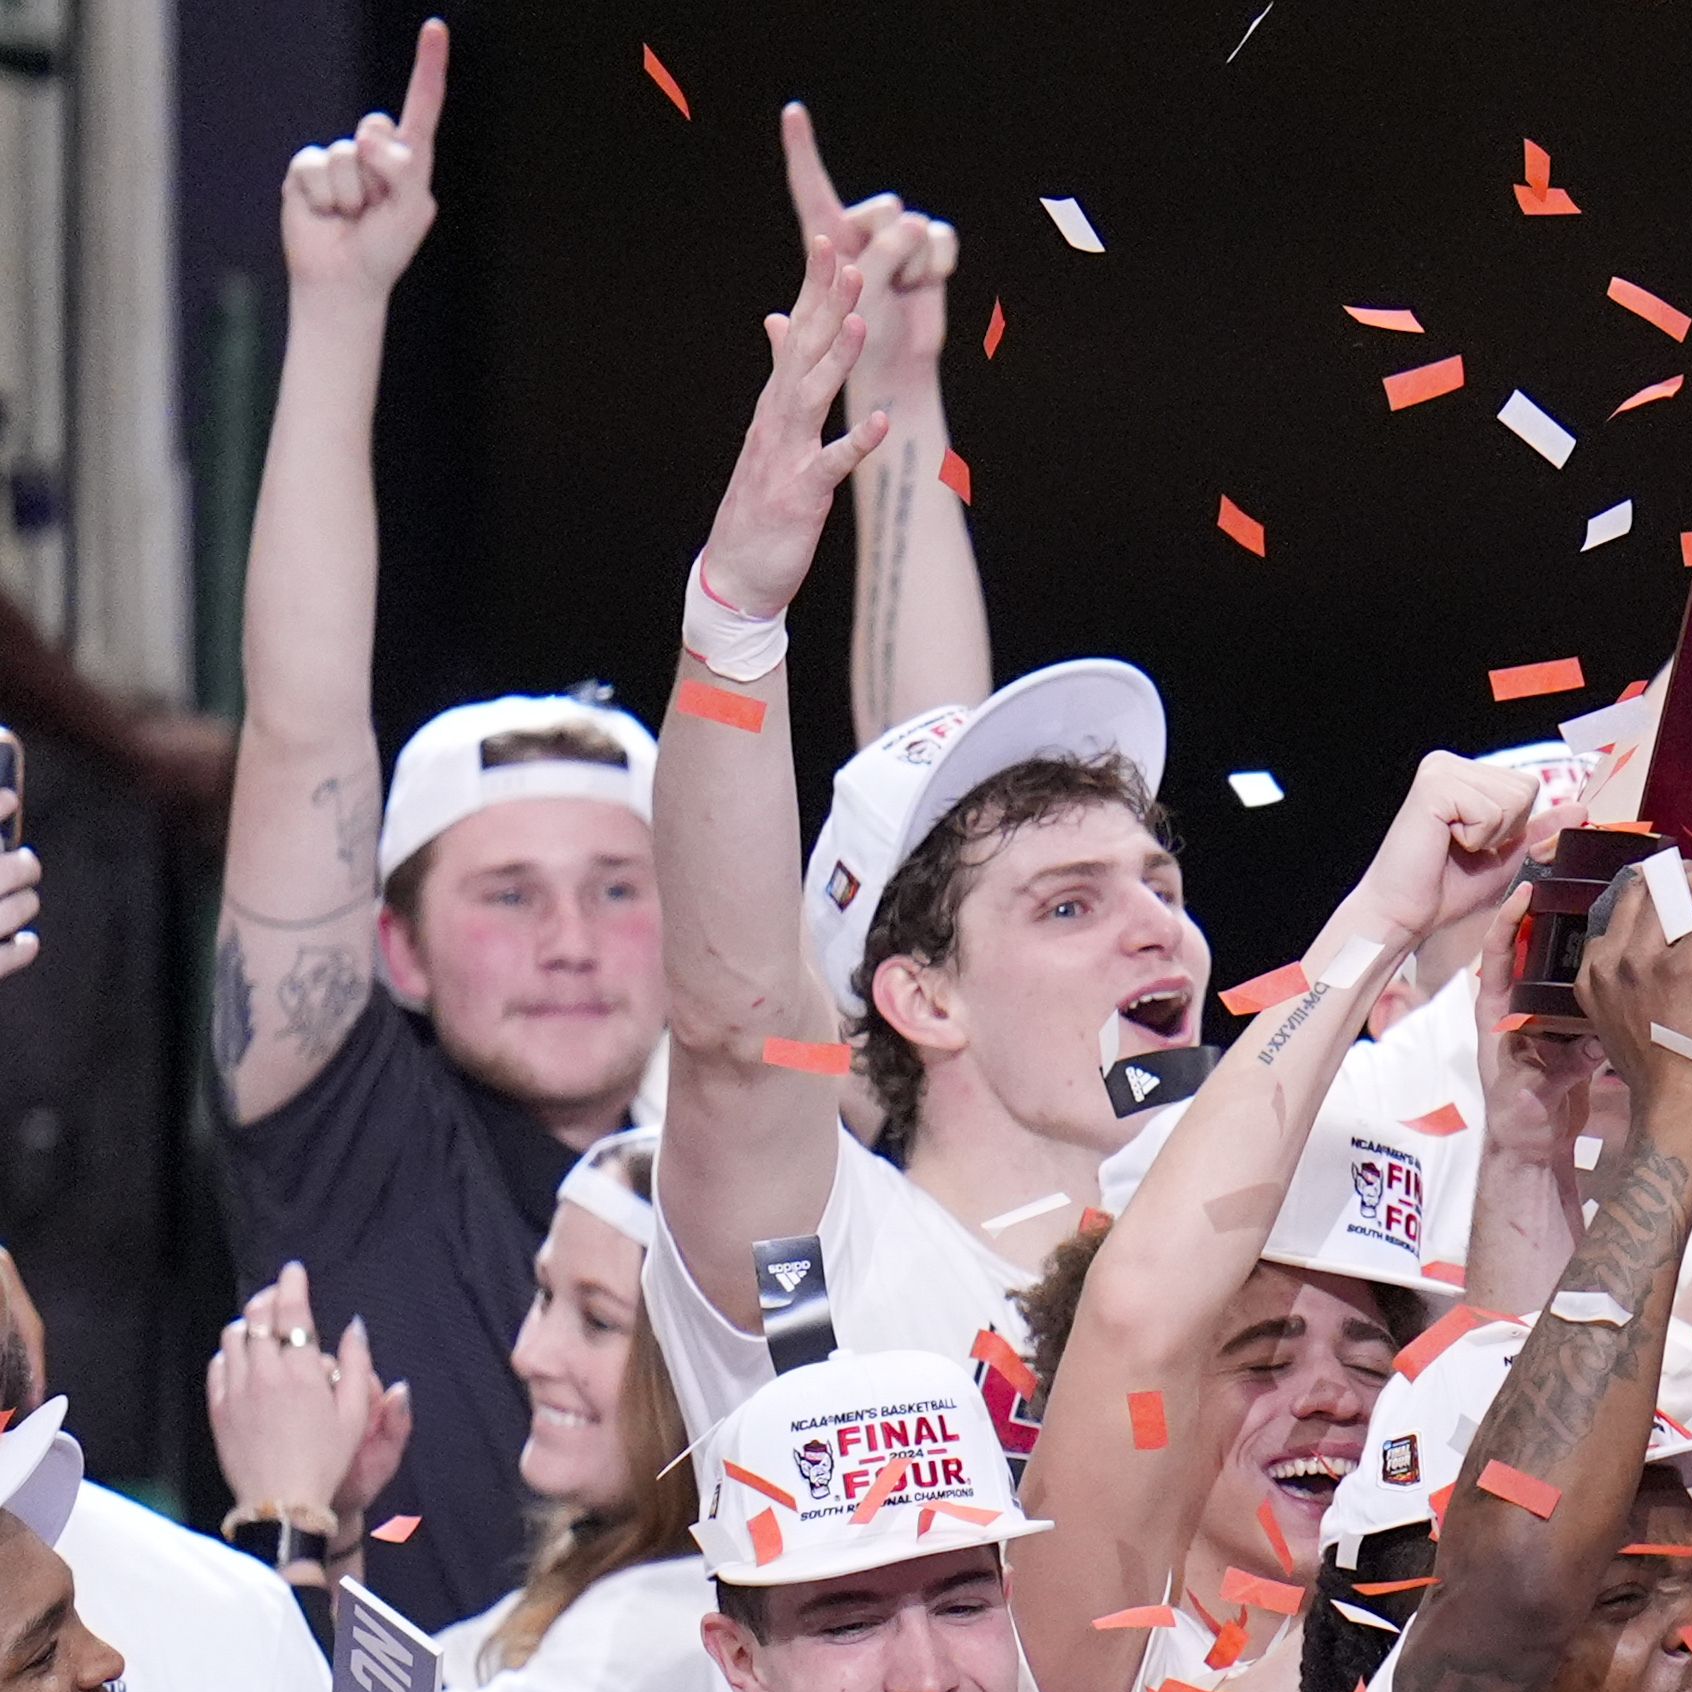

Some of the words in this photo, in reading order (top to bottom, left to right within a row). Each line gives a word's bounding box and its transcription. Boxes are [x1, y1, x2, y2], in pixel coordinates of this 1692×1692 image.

[831, 1406, 878, 1425] MEN'S
[880, 1397, 958, 1419] BASKETBALL
[836, 1414, 960, 1457] FINAL
[800, 1504, 845, 1522] SOUTH
[914, 1487, 975, 1503] CHAMPIONS
